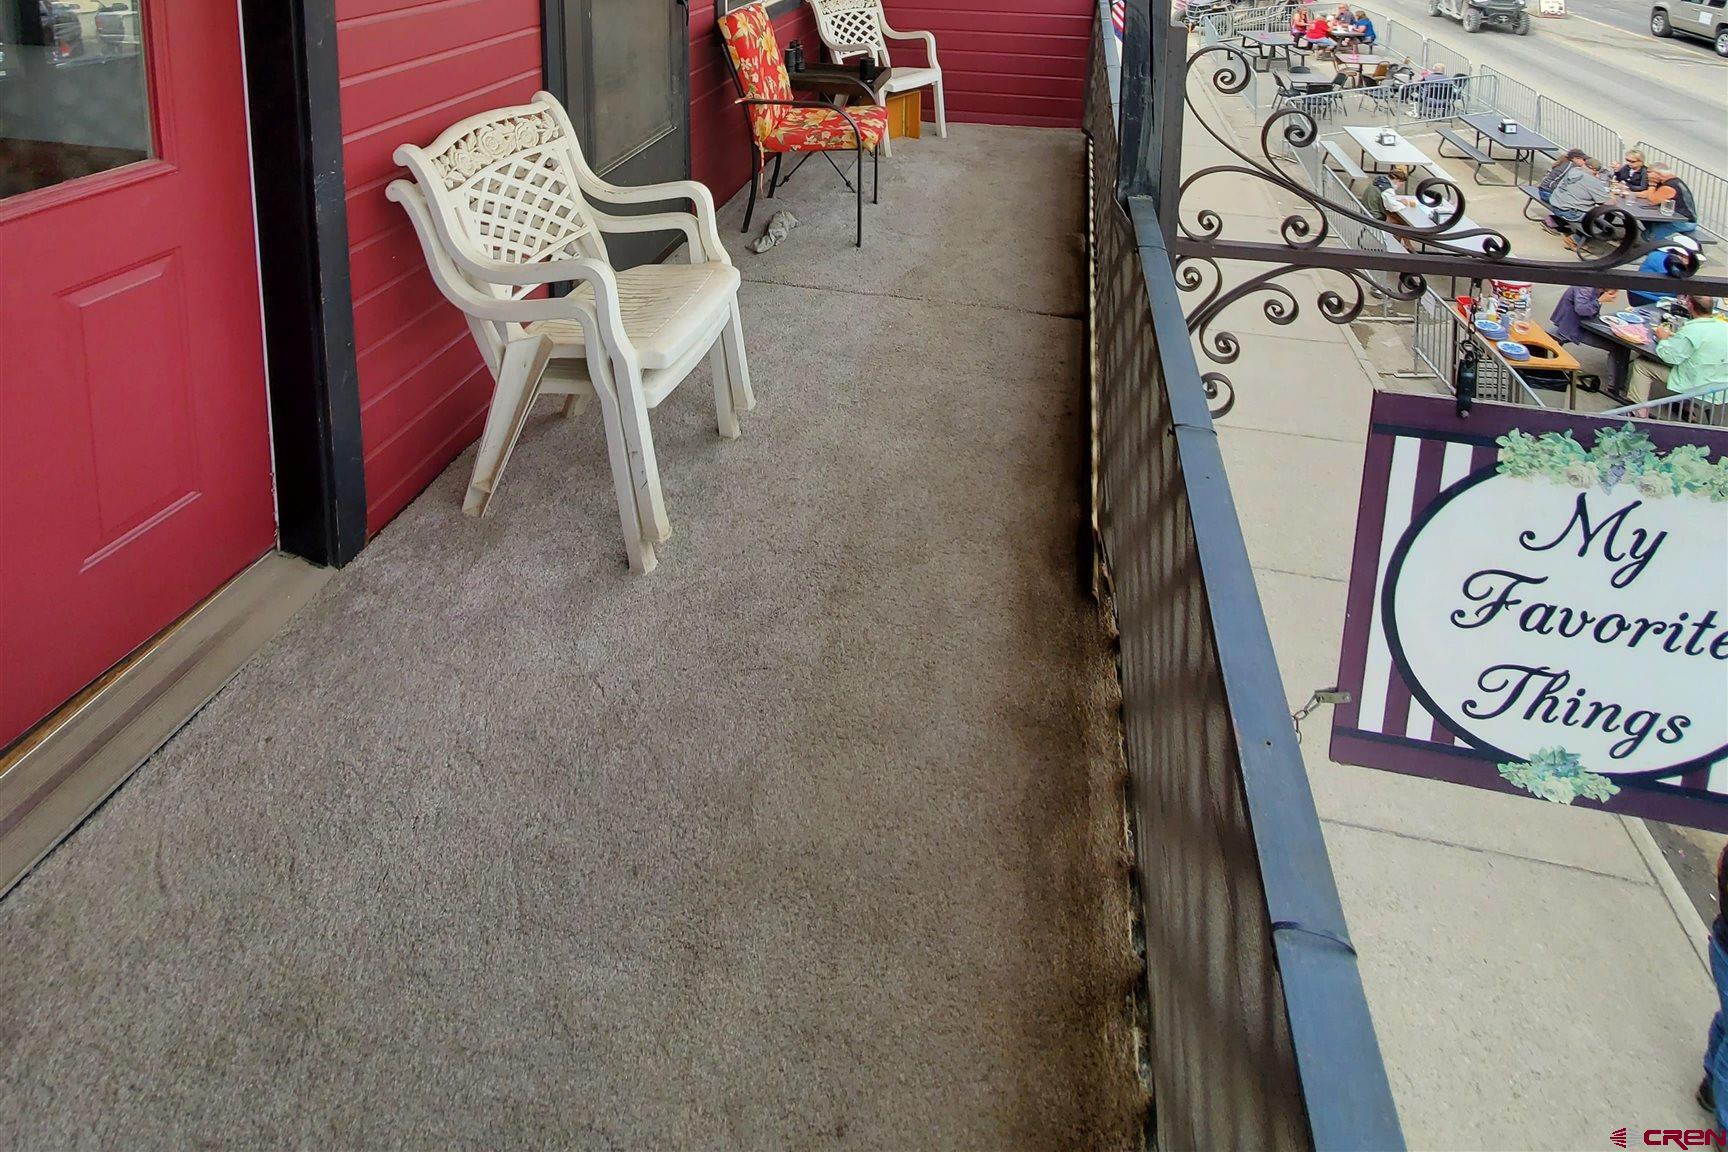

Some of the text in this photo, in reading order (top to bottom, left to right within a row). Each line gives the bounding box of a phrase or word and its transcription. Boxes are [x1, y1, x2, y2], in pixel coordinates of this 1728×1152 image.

[1519, 492, 1668, 589] My
[1450, 569, 1728, 660] Favorite
[1461, 664, 1692, 760] Things
